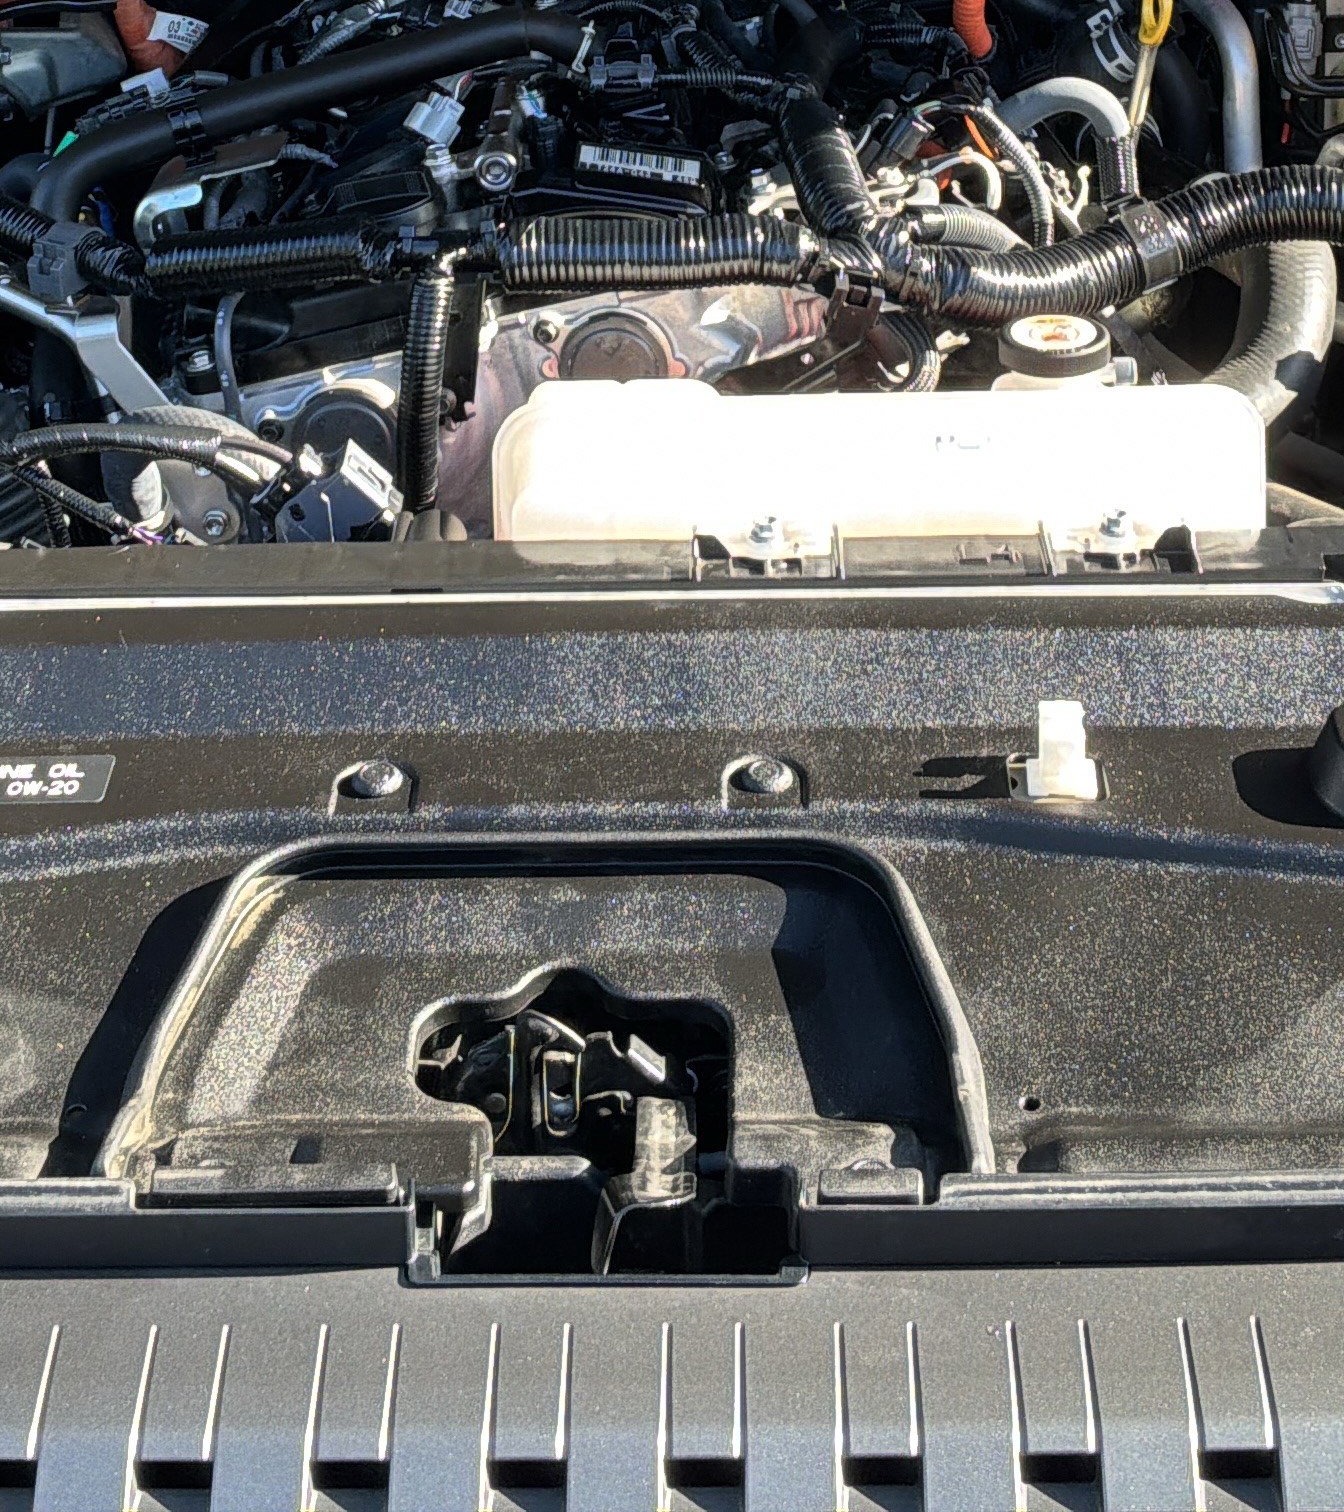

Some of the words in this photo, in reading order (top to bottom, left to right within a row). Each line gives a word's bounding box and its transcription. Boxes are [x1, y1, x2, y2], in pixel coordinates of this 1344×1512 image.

[168, 20, 181, 34] 03
[48, 763, 85, 779] OIL
[6, 780, 80, 797] 0W-20
